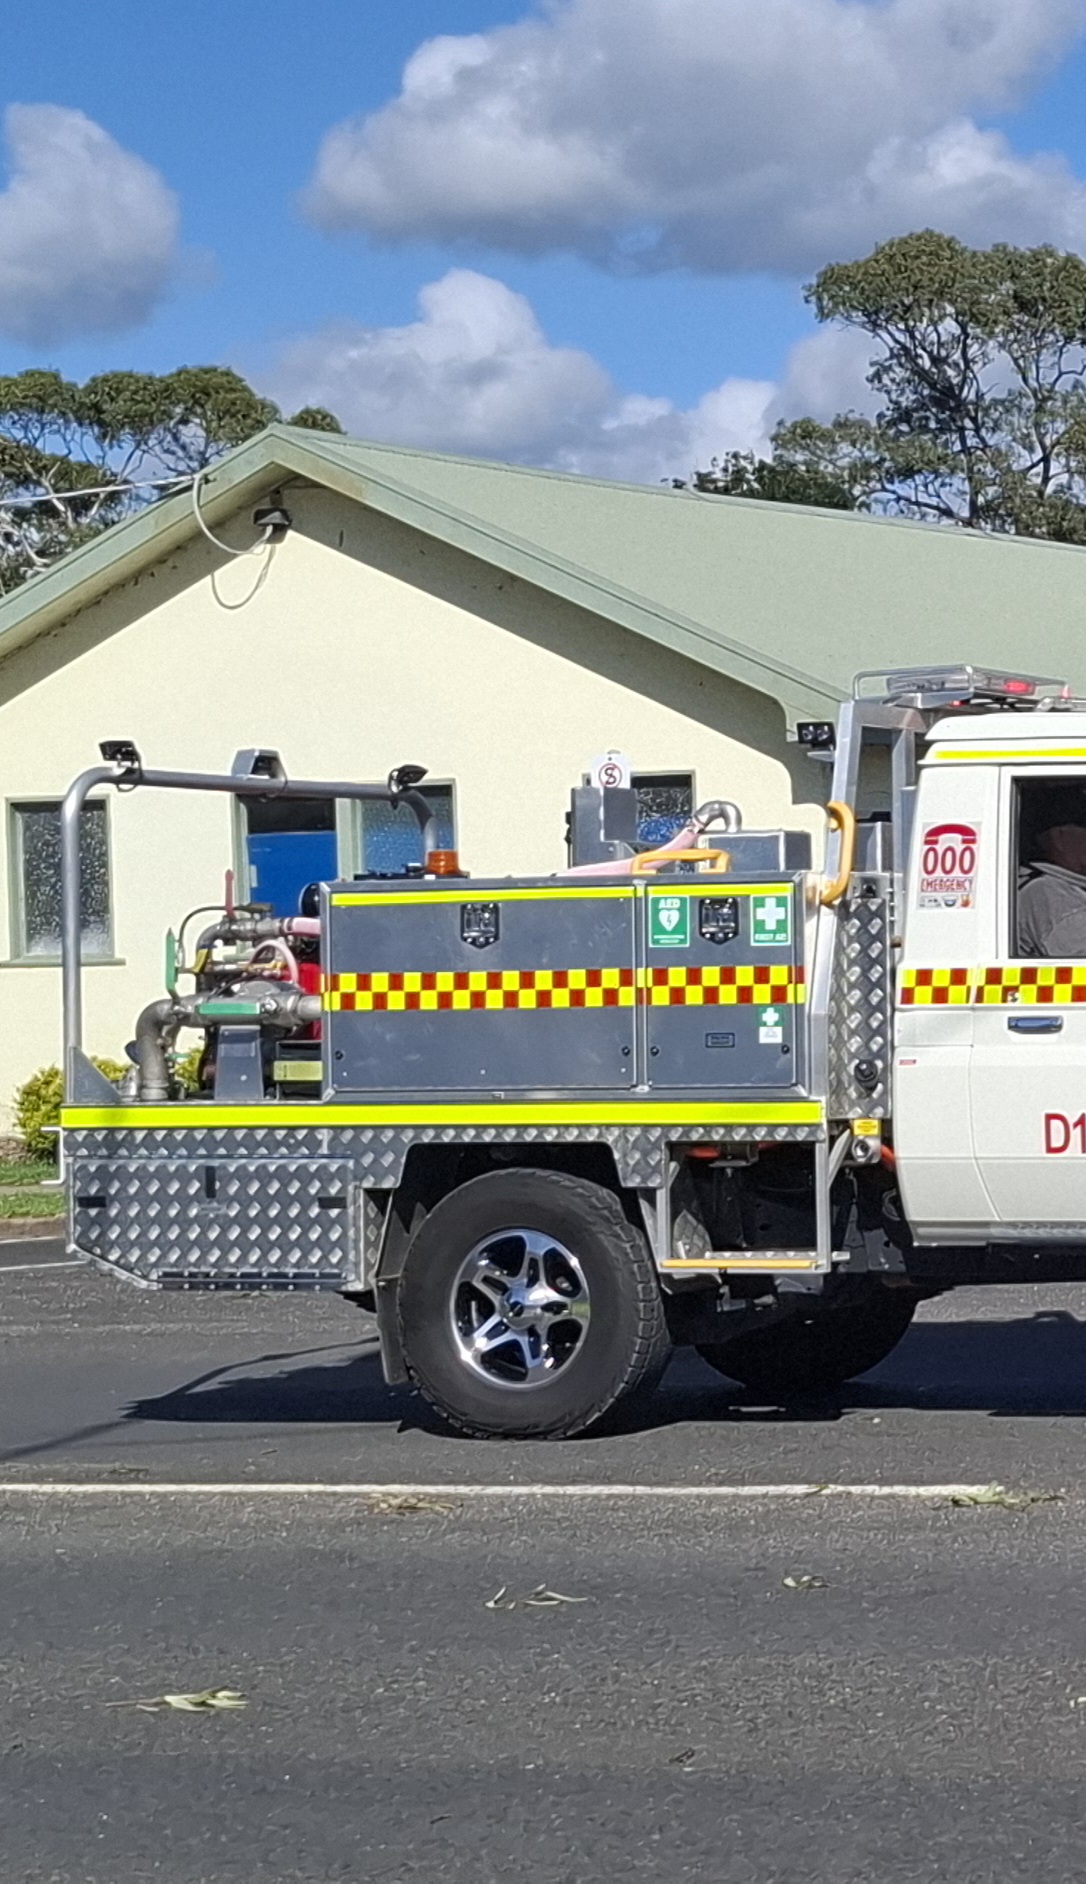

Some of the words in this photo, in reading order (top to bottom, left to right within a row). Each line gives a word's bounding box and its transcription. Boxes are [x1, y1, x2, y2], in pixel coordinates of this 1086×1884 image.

[922, 845, 976, 876] 000
[920, 878, 974, 893] EMERGENCY
[658, 898, 681, 909] AED
